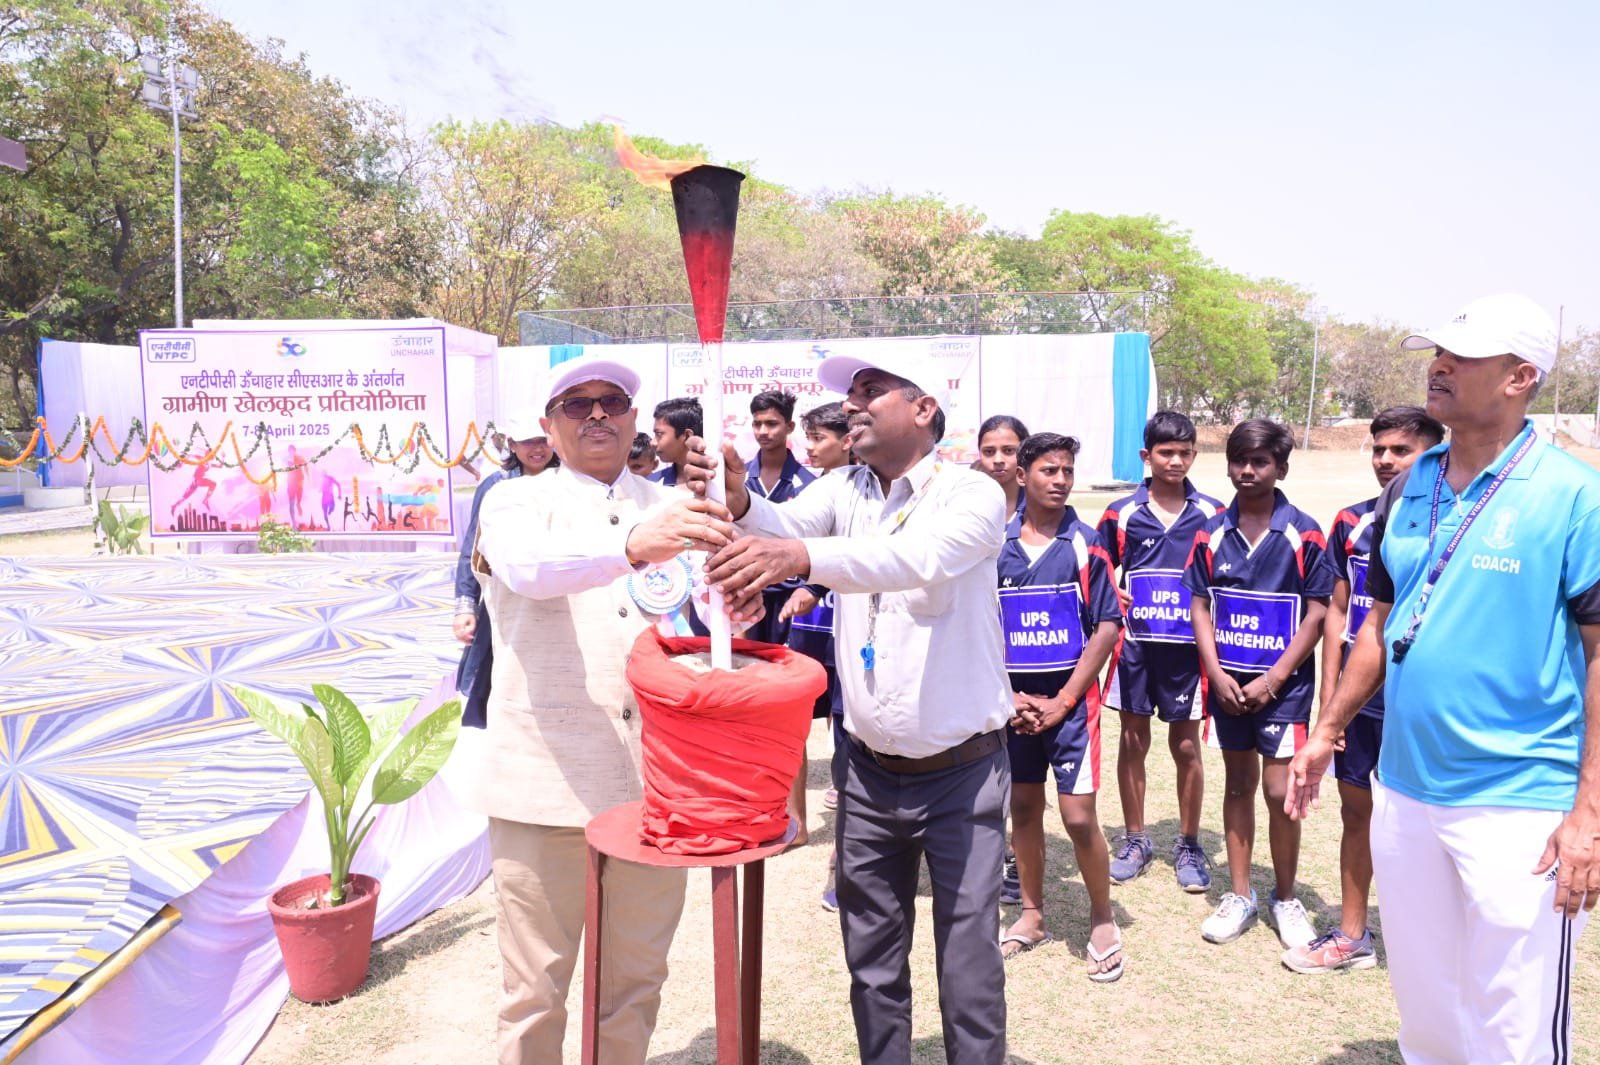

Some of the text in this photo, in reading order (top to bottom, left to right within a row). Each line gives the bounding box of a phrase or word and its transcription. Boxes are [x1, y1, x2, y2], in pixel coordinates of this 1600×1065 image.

[154, 352, 189, 360] NTPC
[390, 348, 435, 357] UNCHAHAR
[181, 368, 405, 389] एनटीपीसी ऊँचाहार सीएसआर के अंतर्गत
[722, 365, 764, 379] टीपीसी
[161, 389, 427, 418] ग्रामीण खेलकूद प्रतियोगिता
[265, 424, 295, 439] April
[299, 423, 330, 436] 2025
[1447, 515, 1472, 553] CHINMAYA
[1471, 480, 1500, 517] VIDYALAYA
[1471, 554, 1521, 574] COACH
[1152, 590, 1180, 605] UPS
[1021, 611, 1050, 627] UPS
[1132, 606, 1191, 622] GOPALPU
[1230, 613, 1260, 630] UPS
[1010, 628, 1069, 647] UMARAN
